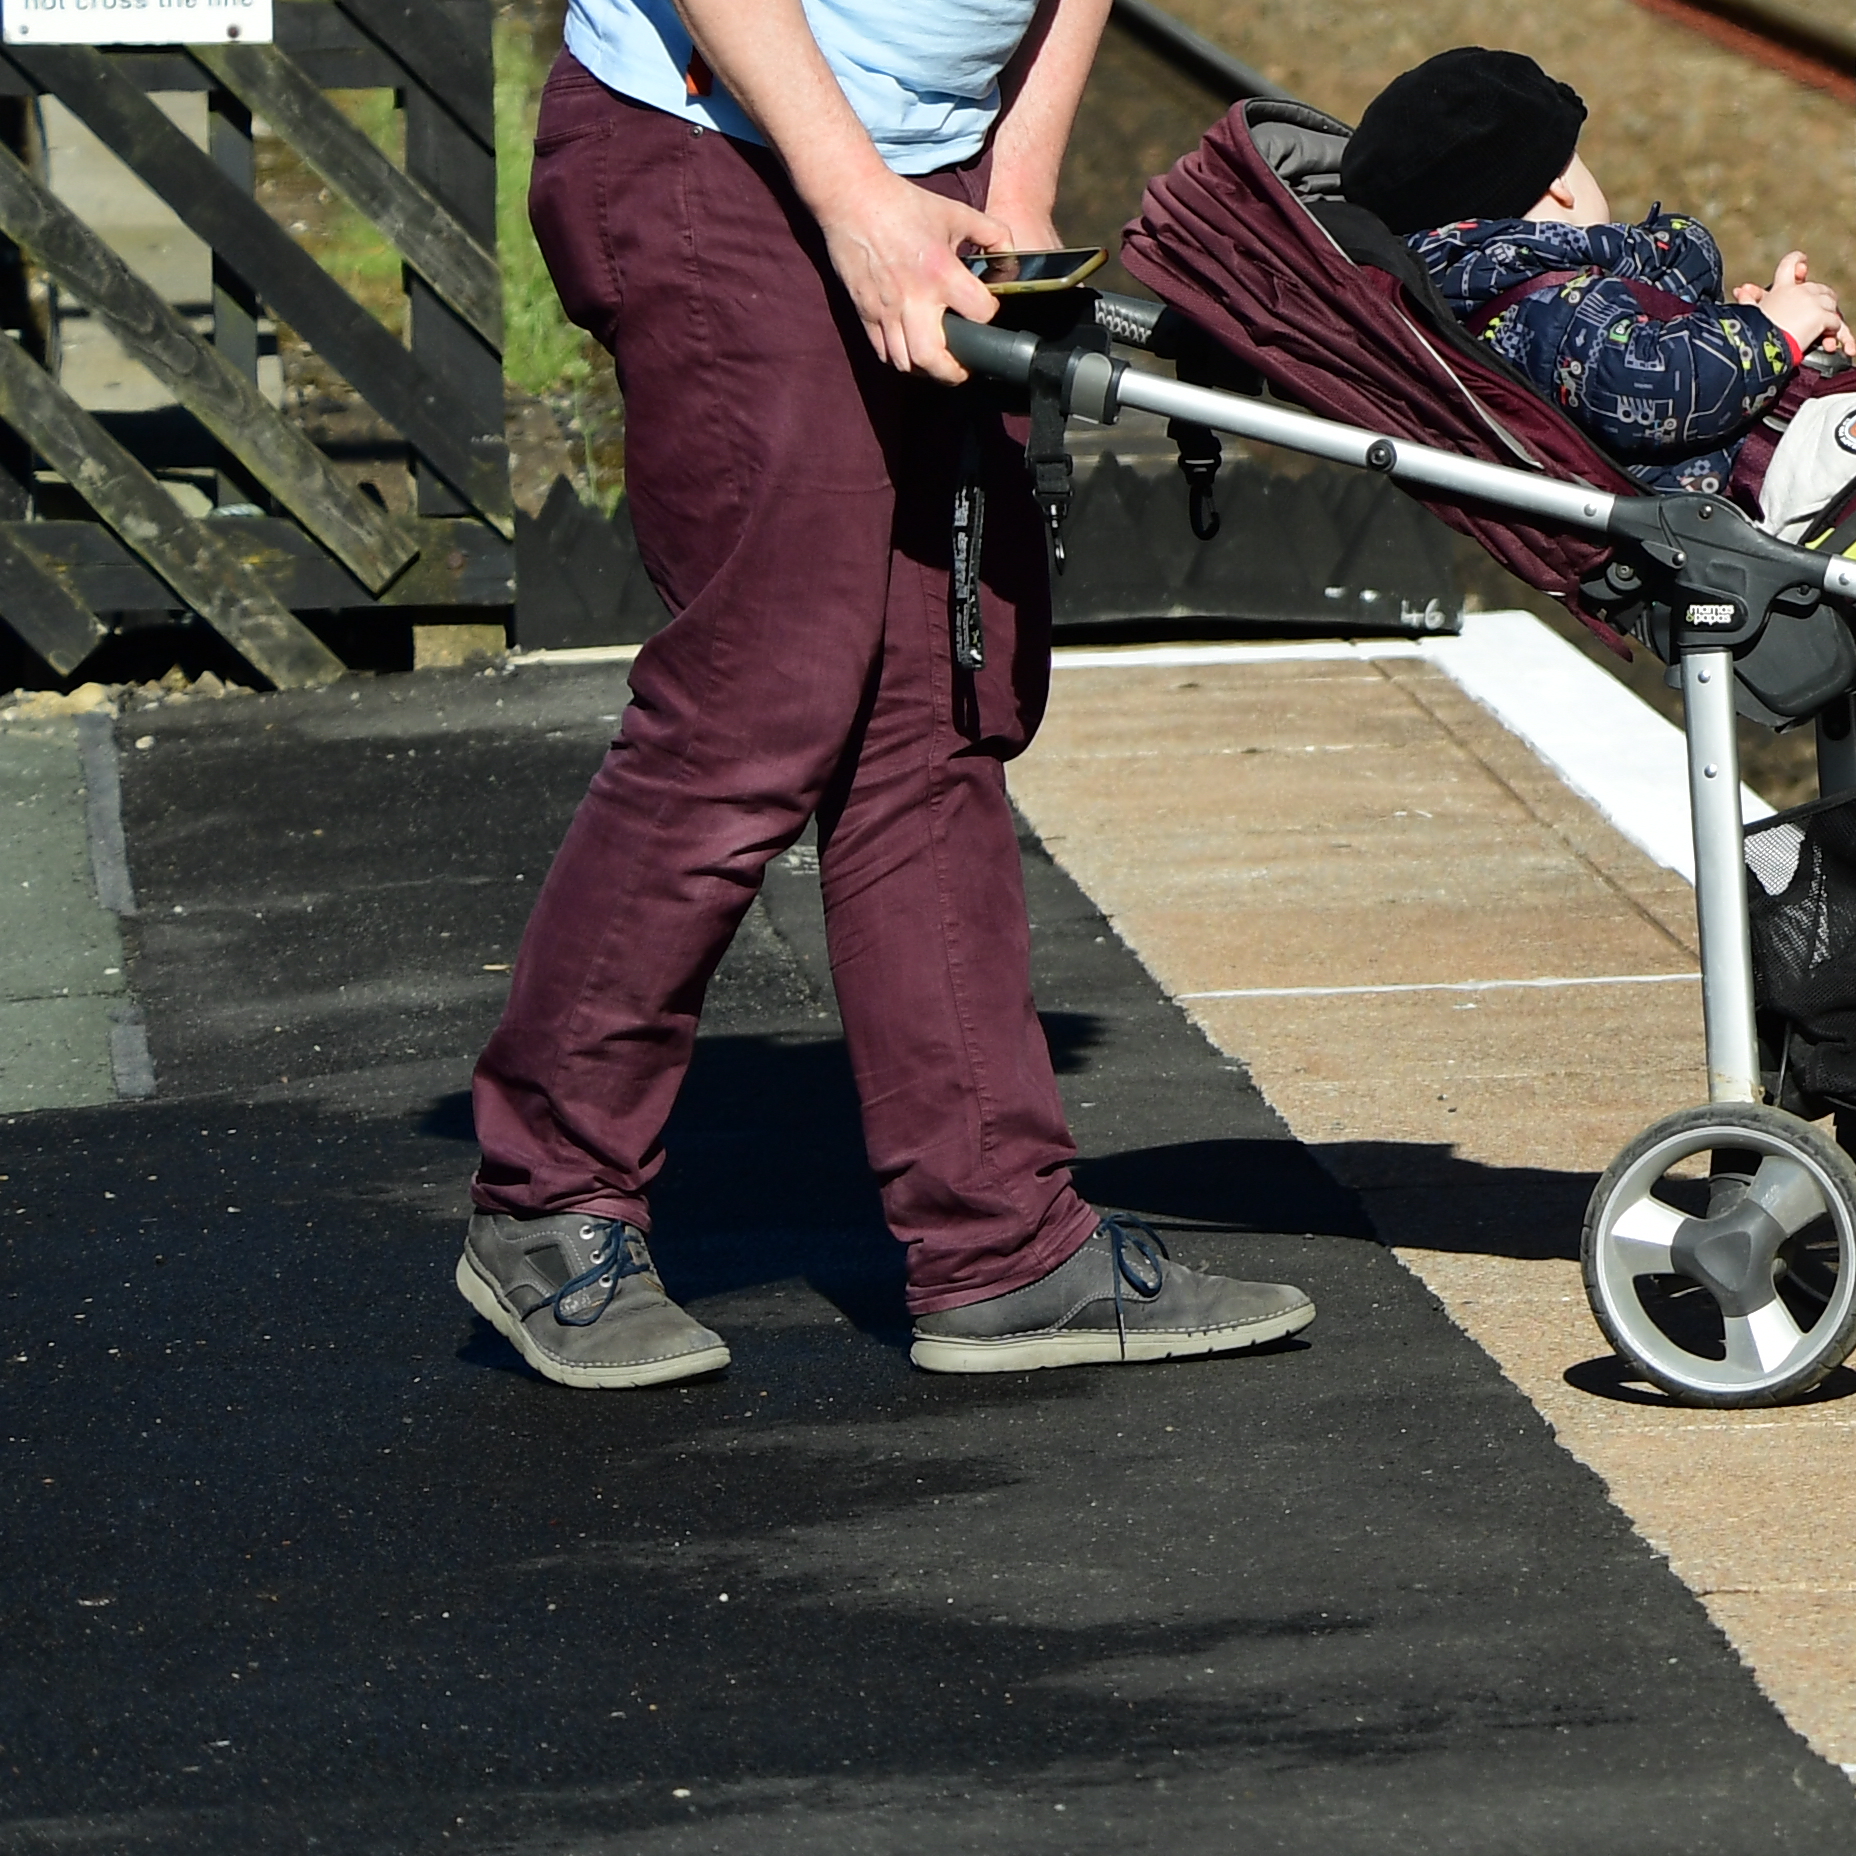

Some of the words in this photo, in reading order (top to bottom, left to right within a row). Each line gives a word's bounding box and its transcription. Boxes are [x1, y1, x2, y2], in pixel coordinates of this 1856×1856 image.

[1401, 598, 1446, 630] 46
[1690, 605, 1735, 615] mamas
[1694, 614, 1731, 626] papas
